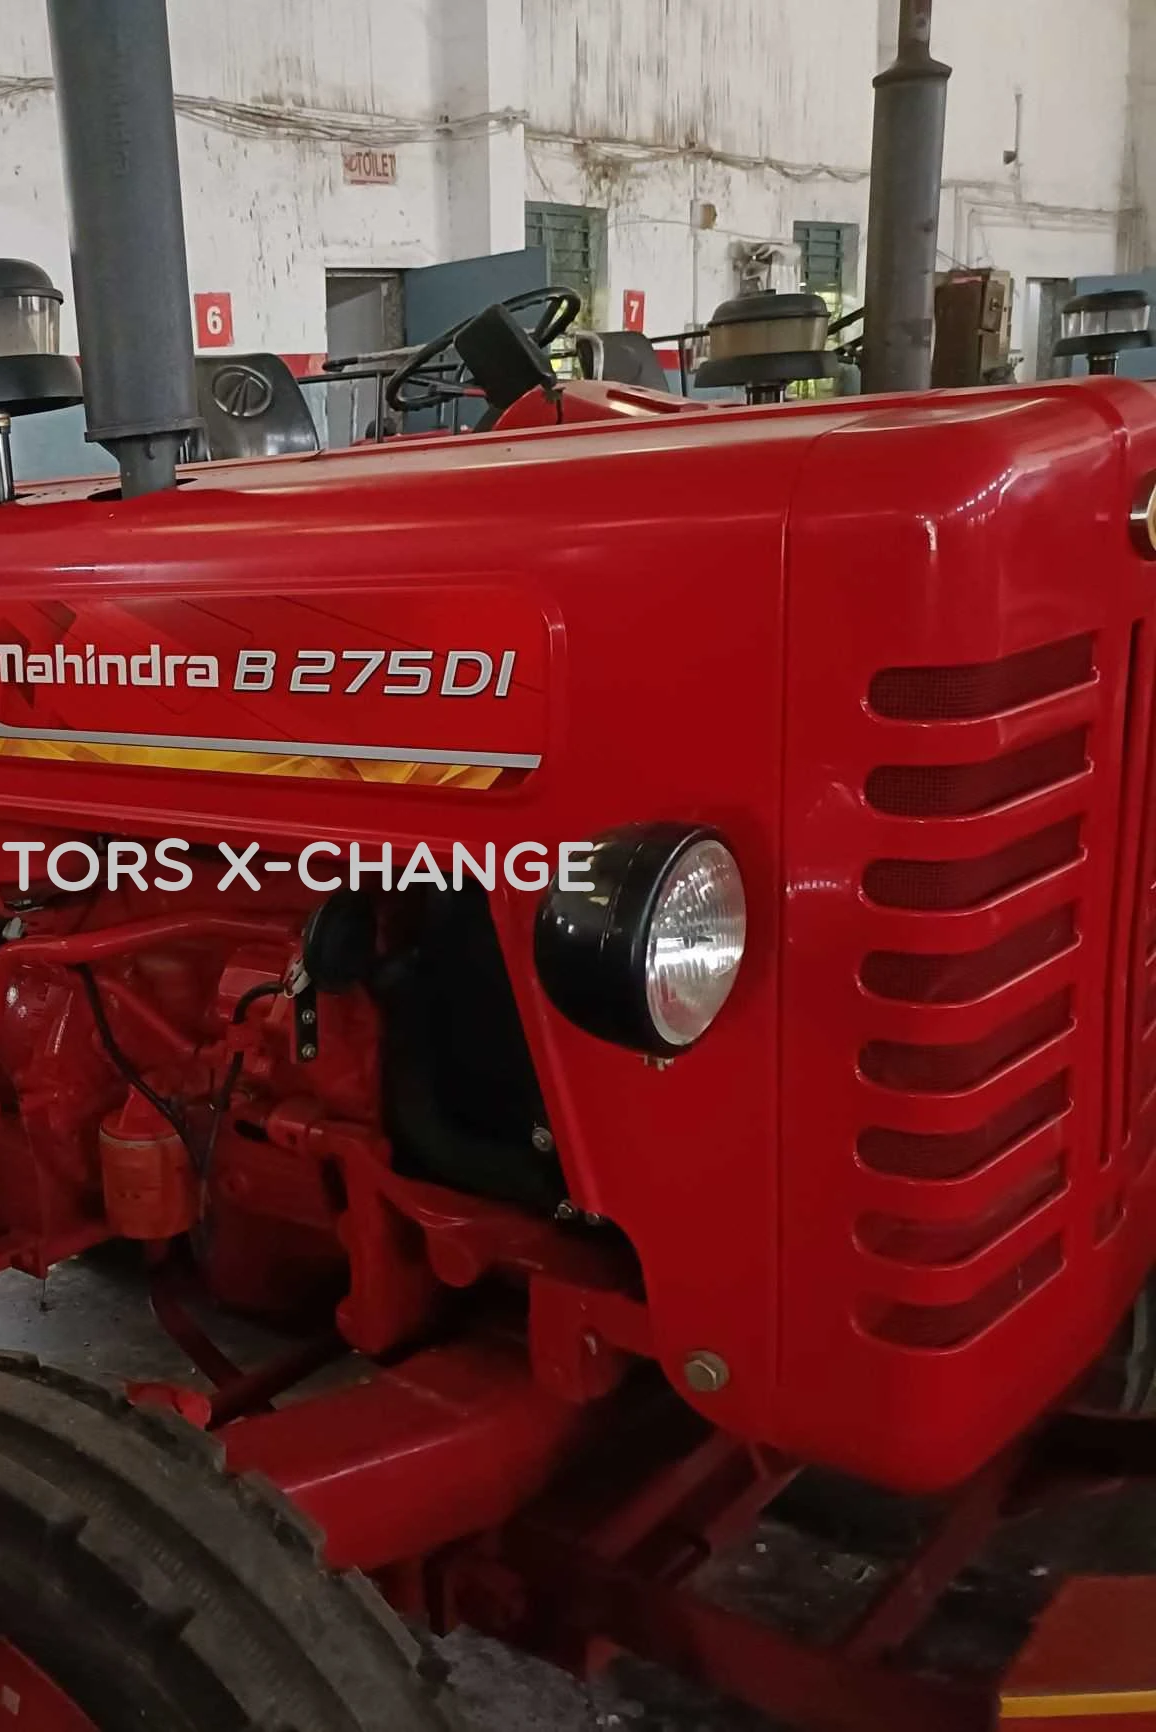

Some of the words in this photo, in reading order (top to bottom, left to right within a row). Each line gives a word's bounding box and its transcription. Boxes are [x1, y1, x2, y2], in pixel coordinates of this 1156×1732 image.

[355, 151, 396, 177] TOILET
[206, 305, 223, 335] 6
[630, 300, 640, 322] 7
[233, 649, 277, 691] B
